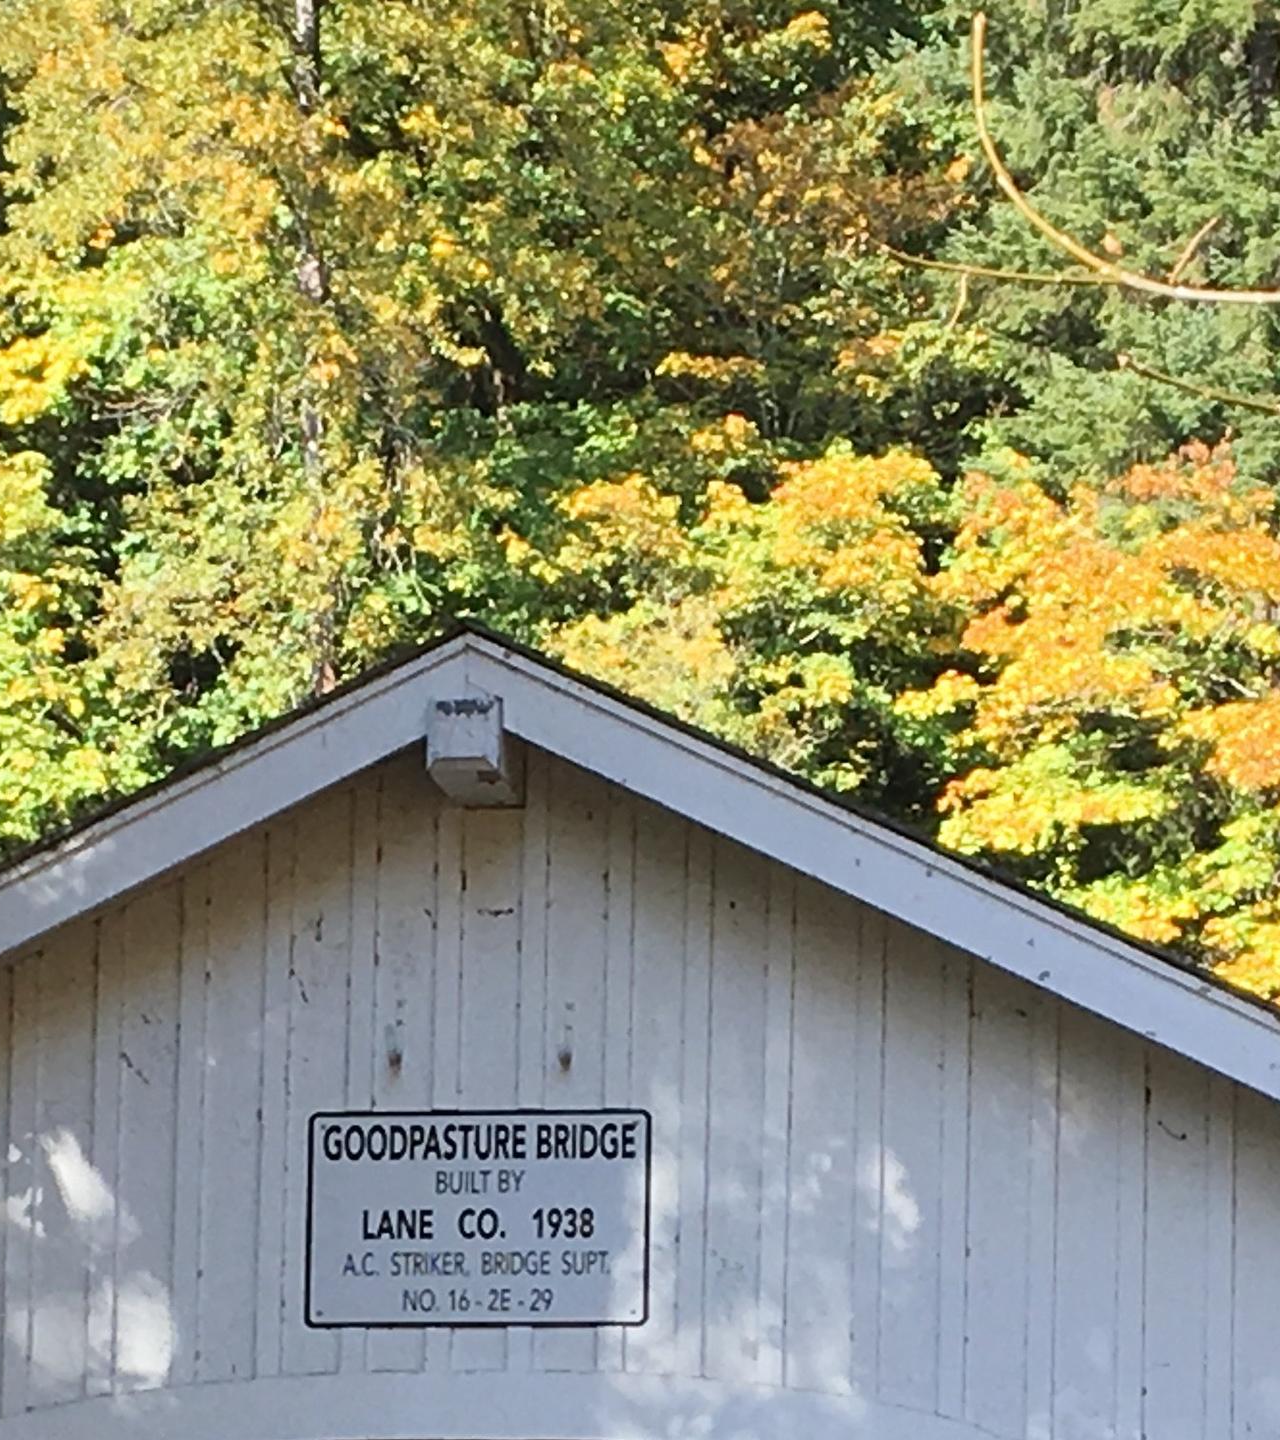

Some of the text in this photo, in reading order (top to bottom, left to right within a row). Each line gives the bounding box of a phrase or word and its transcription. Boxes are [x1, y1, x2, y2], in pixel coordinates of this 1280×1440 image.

[322, 1123, 637, 1161] GOODPASTURE BRIDGE
[435, 1169, 526, 1195] BUILT BY
[362, 1207, 595, 1240] LANE CO. 1938
[342, 1251, 380, 1277] A.C.
[481, 1250, 551, 1276] BRIDGE
[561, 1250, 611, 1276] SUPT.
[402, 1288, 440, 1313] NO.
